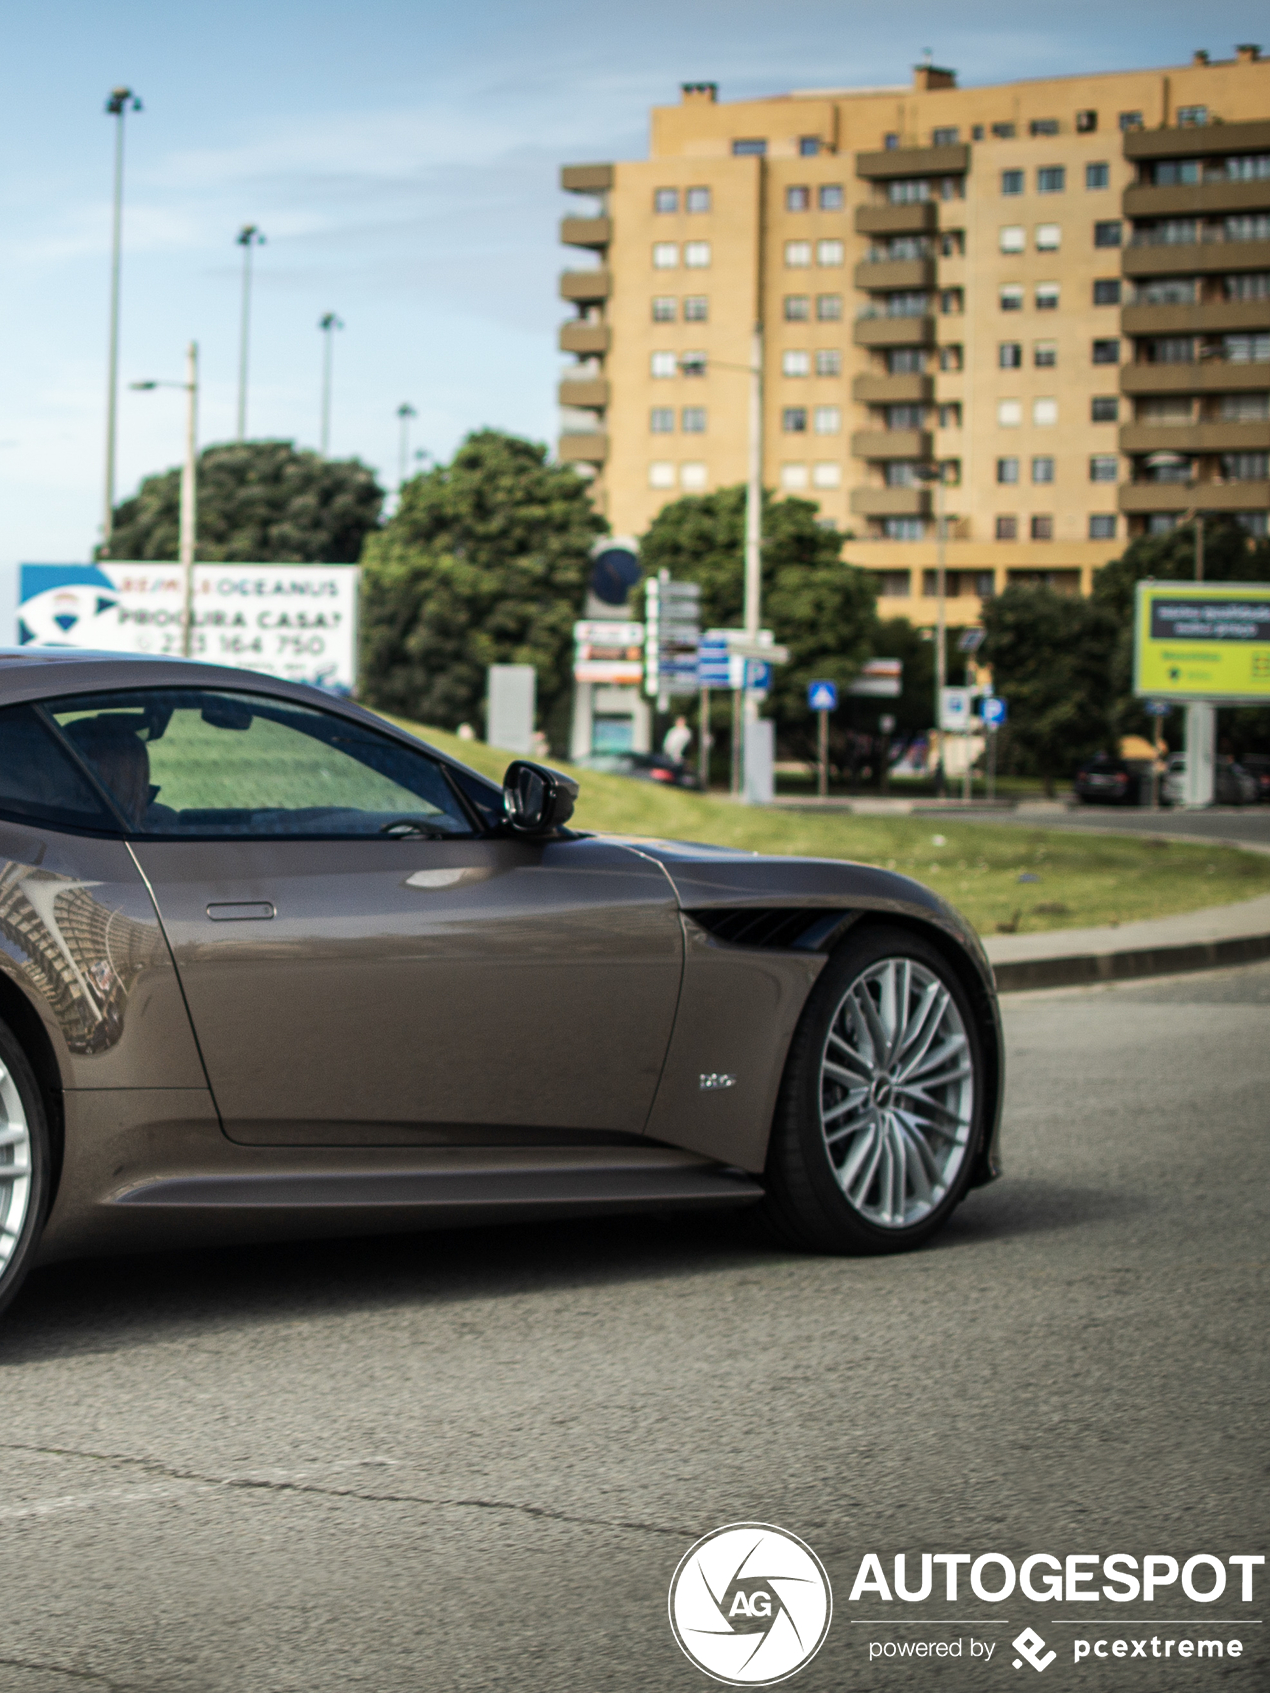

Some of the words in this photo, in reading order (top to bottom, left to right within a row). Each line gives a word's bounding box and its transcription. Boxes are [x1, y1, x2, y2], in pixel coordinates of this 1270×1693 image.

[216, 578, 338, 597] OCEANUS
[118, 609, 246, 628] PROCURA
[219, 634, 263, 654] 164
[277, 634, 326, 655] 750
